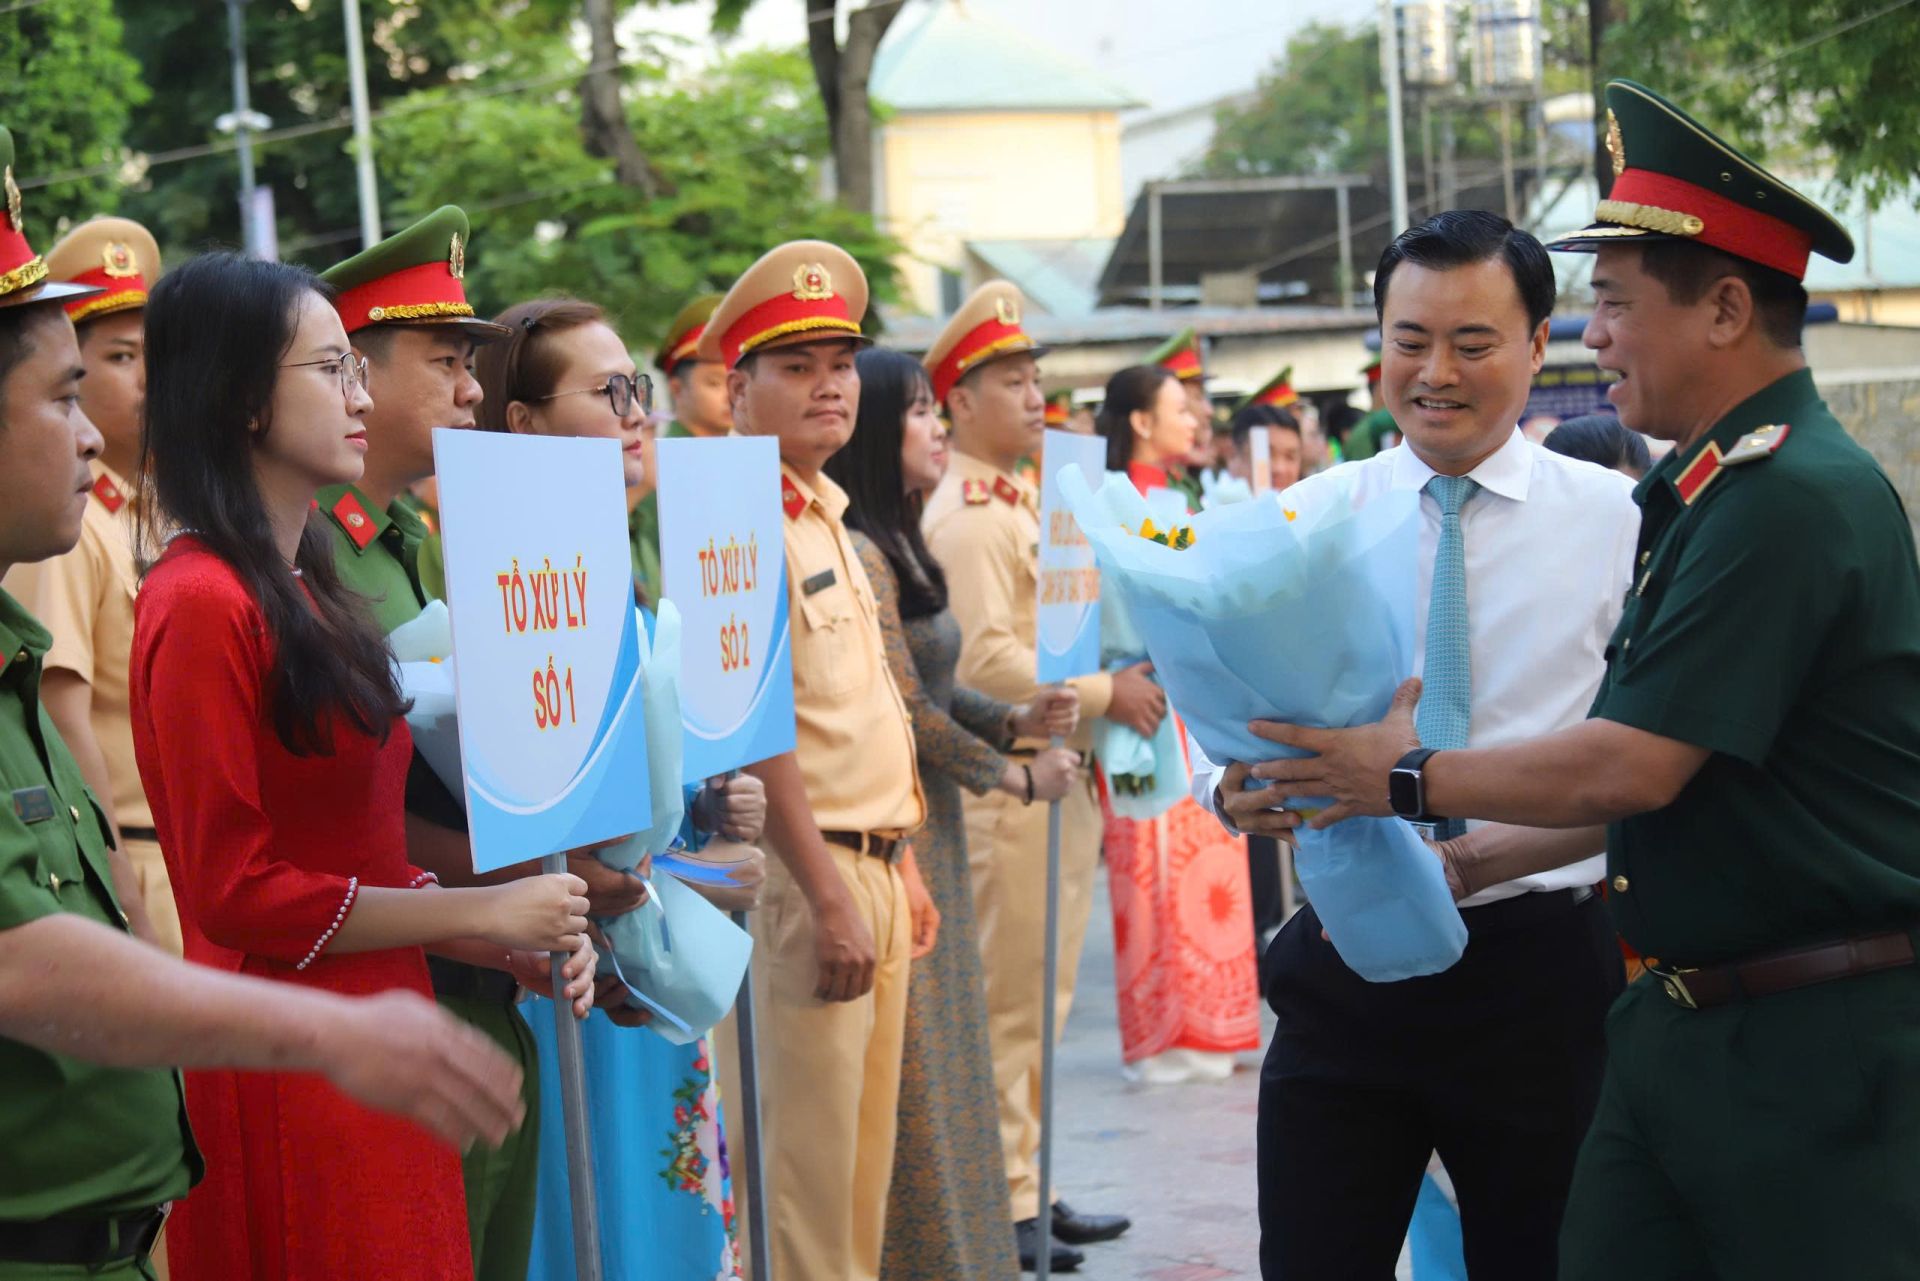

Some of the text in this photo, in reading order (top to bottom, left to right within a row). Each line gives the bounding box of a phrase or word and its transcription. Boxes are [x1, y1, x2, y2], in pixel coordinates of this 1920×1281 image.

[497, 555, 587, 633] TỔ XỬ LÝ
[699, 531, 758, 597] TỔ XỬ LÝ
[720, 611, 750, 673] SỐ 2
[532, 655, 576, 729] SỐ 1
